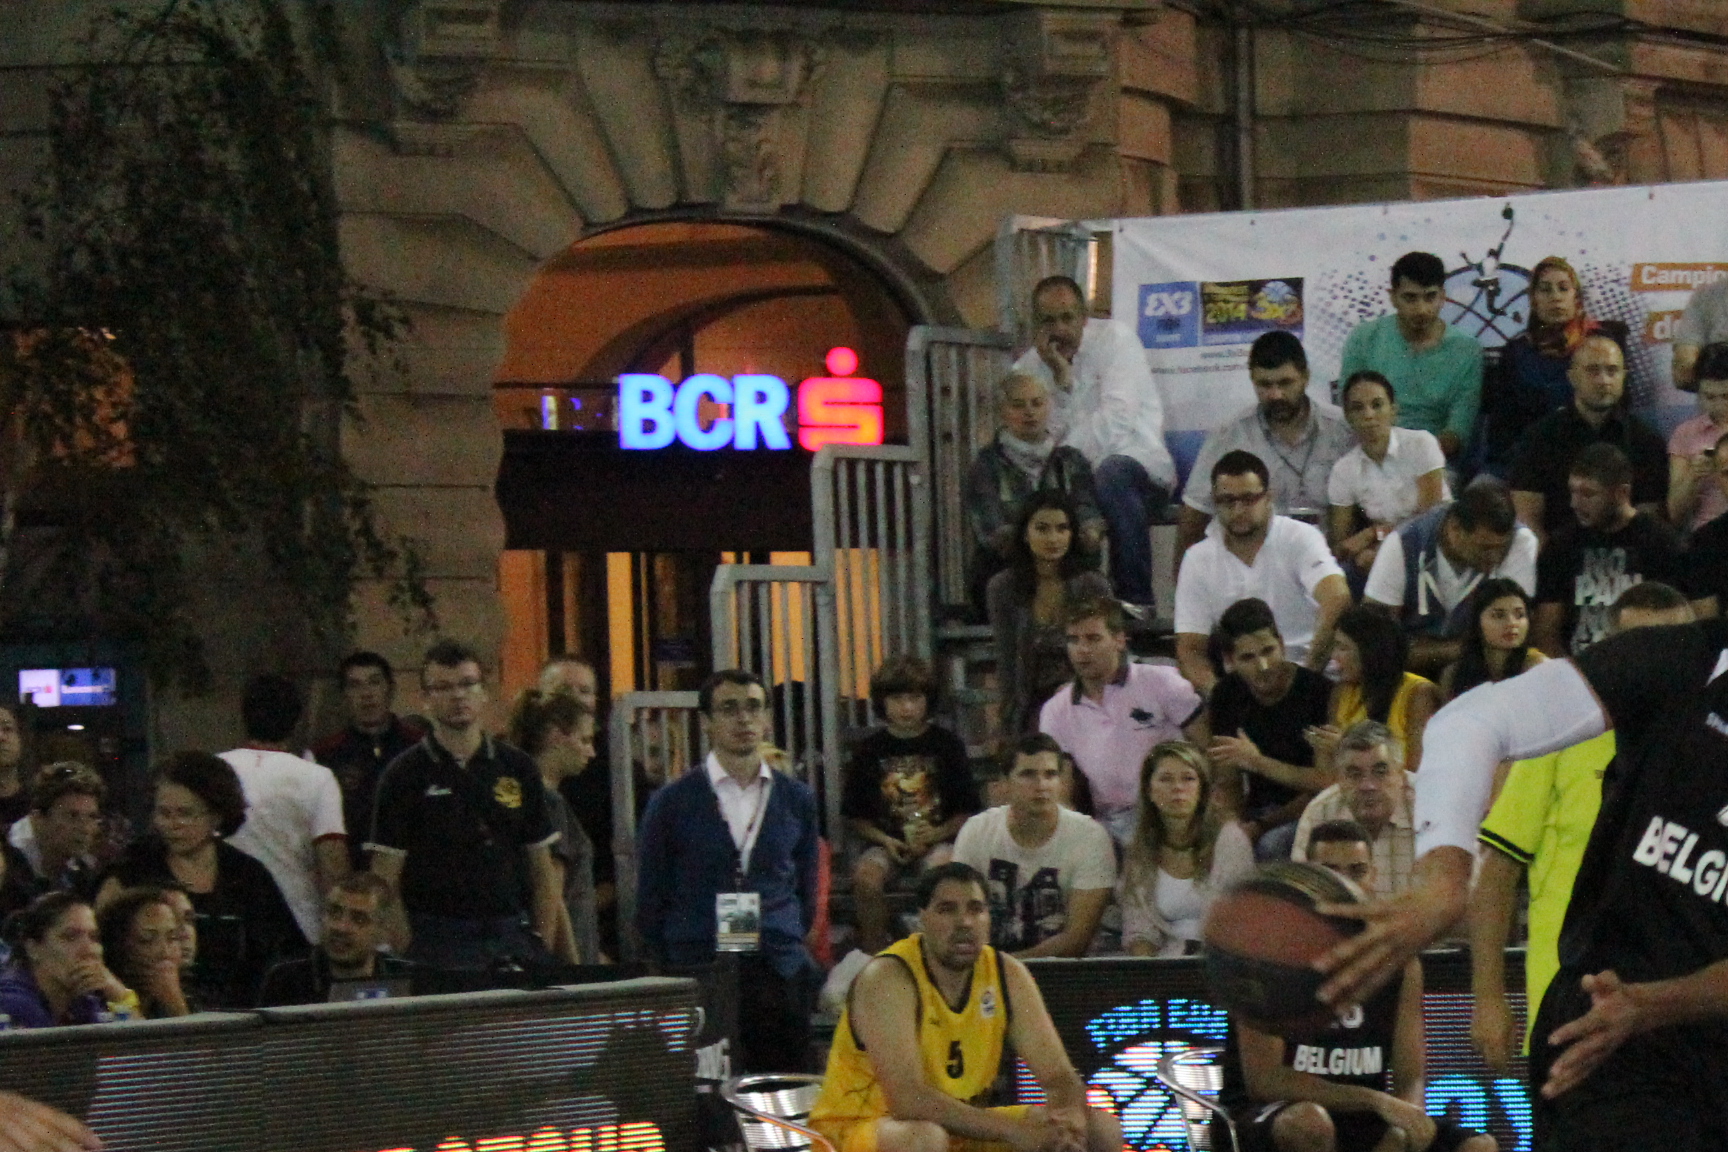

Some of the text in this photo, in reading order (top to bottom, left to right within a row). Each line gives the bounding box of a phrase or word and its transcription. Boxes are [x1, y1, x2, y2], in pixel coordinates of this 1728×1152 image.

[618, 373, 792, 451] BCR
[945, 1039, 966, 1080] 5
[1293, 1043, 1383, 1076] BELGIUM
